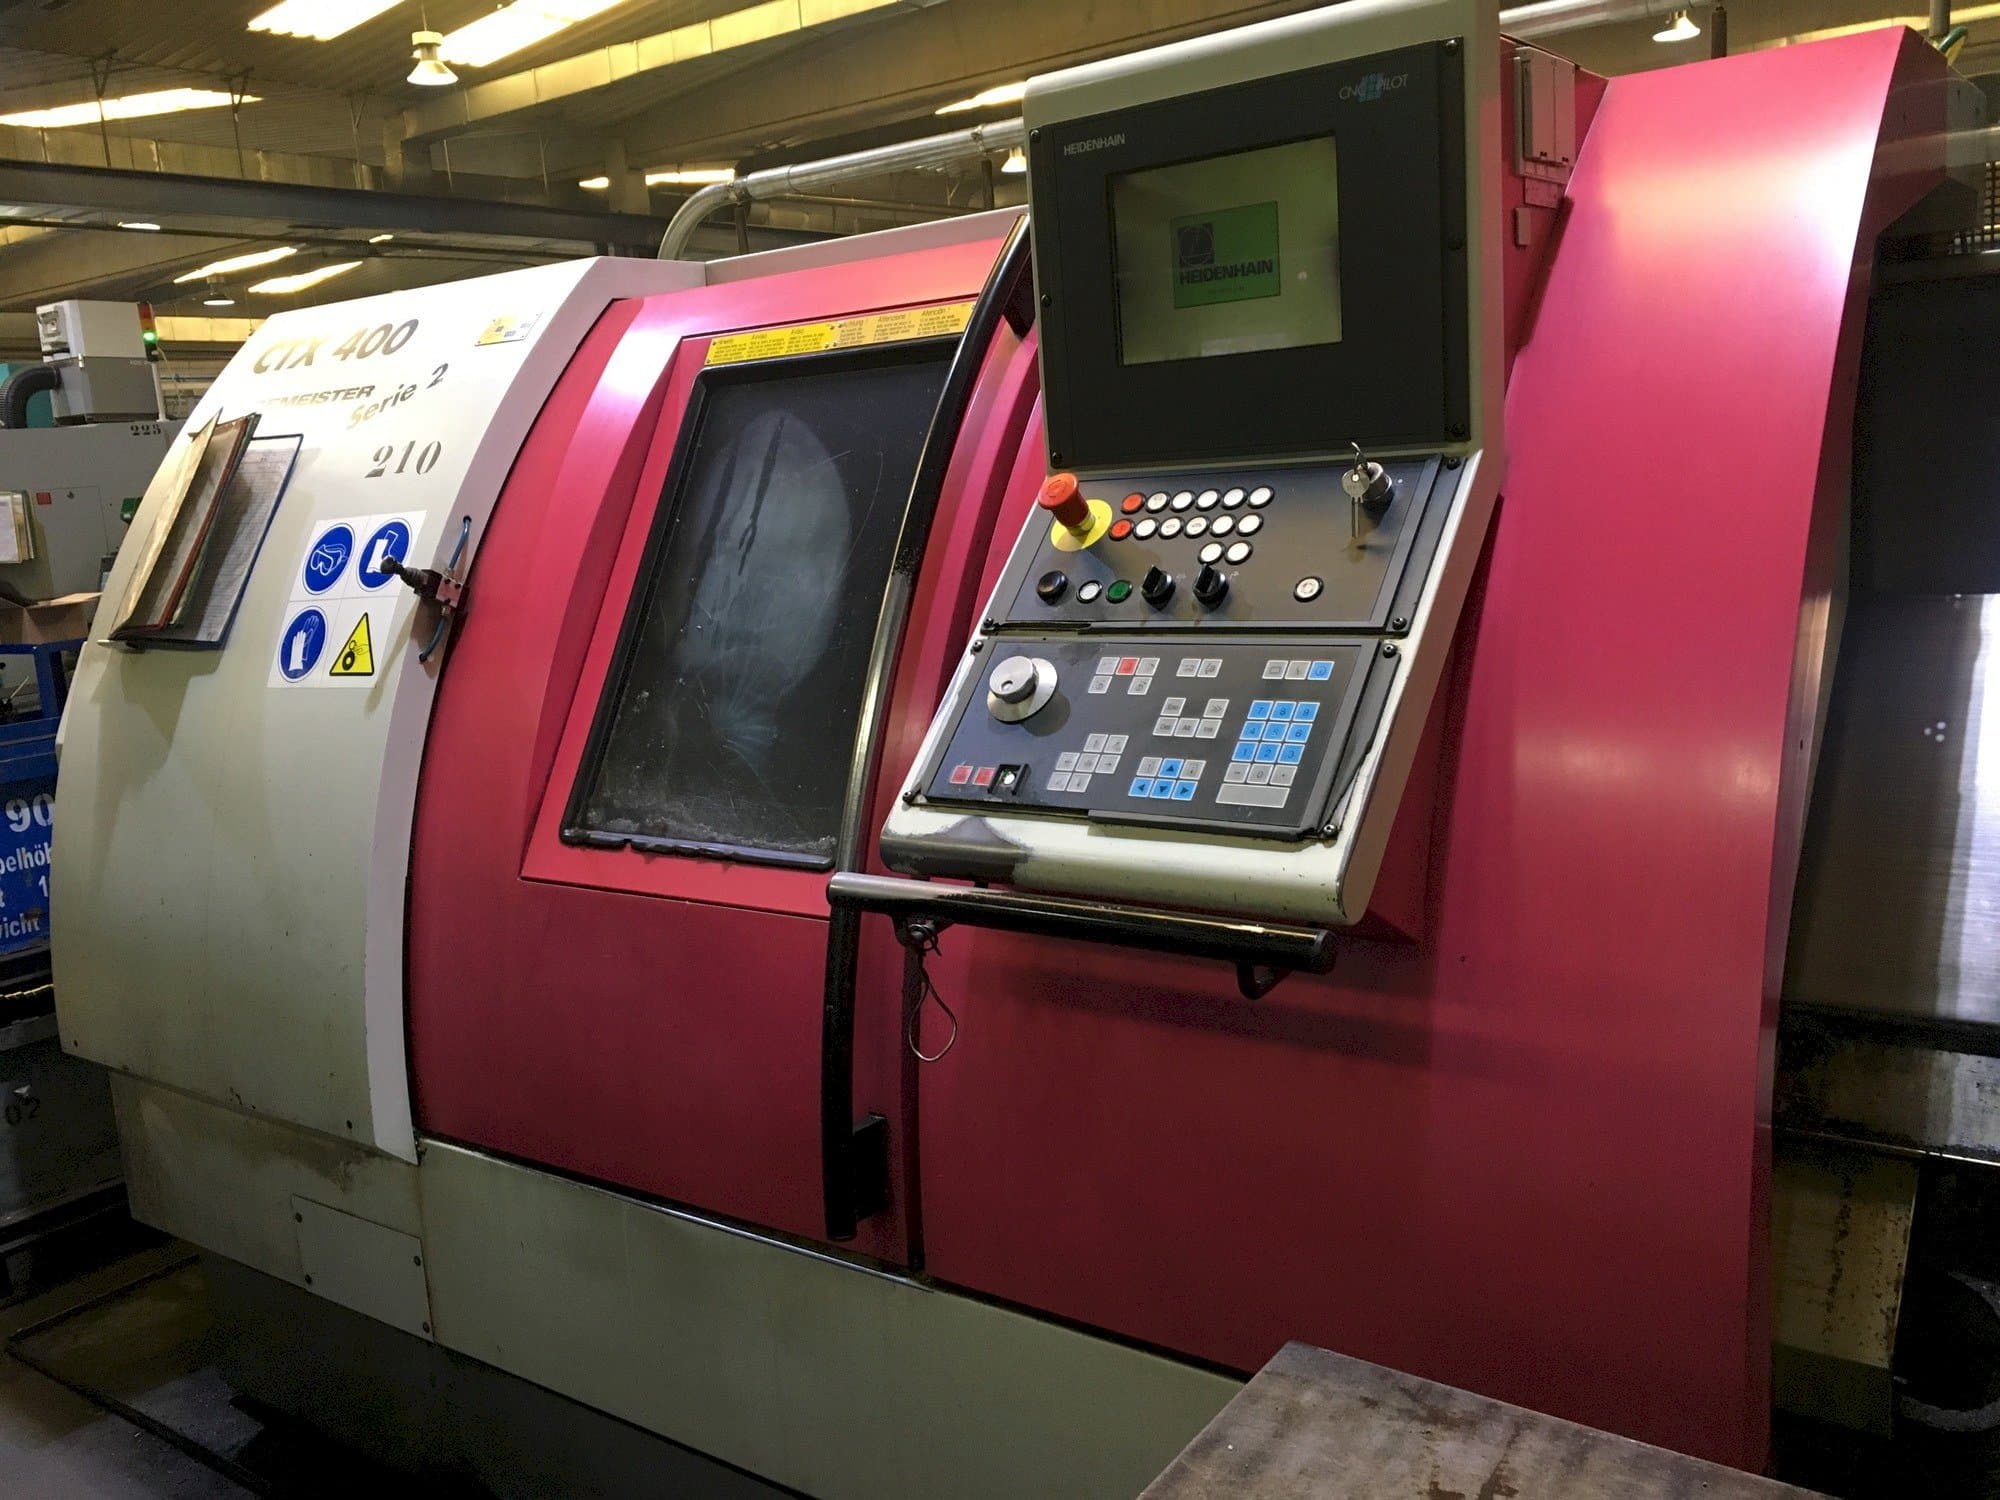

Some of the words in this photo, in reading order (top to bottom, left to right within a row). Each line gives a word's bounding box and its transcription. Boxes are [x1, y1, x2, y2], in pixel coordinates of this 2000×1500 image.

[1063, 133, 1125, 156] HEIDENHAIN
[1180, 260, 1273, 285] HEIDENHAIN
[253, 335, 332, 374] CTX
[332, 319, 419, 361] 400
[427, 363, 449, 389] 2
[364, 440, 442, 479] 210
